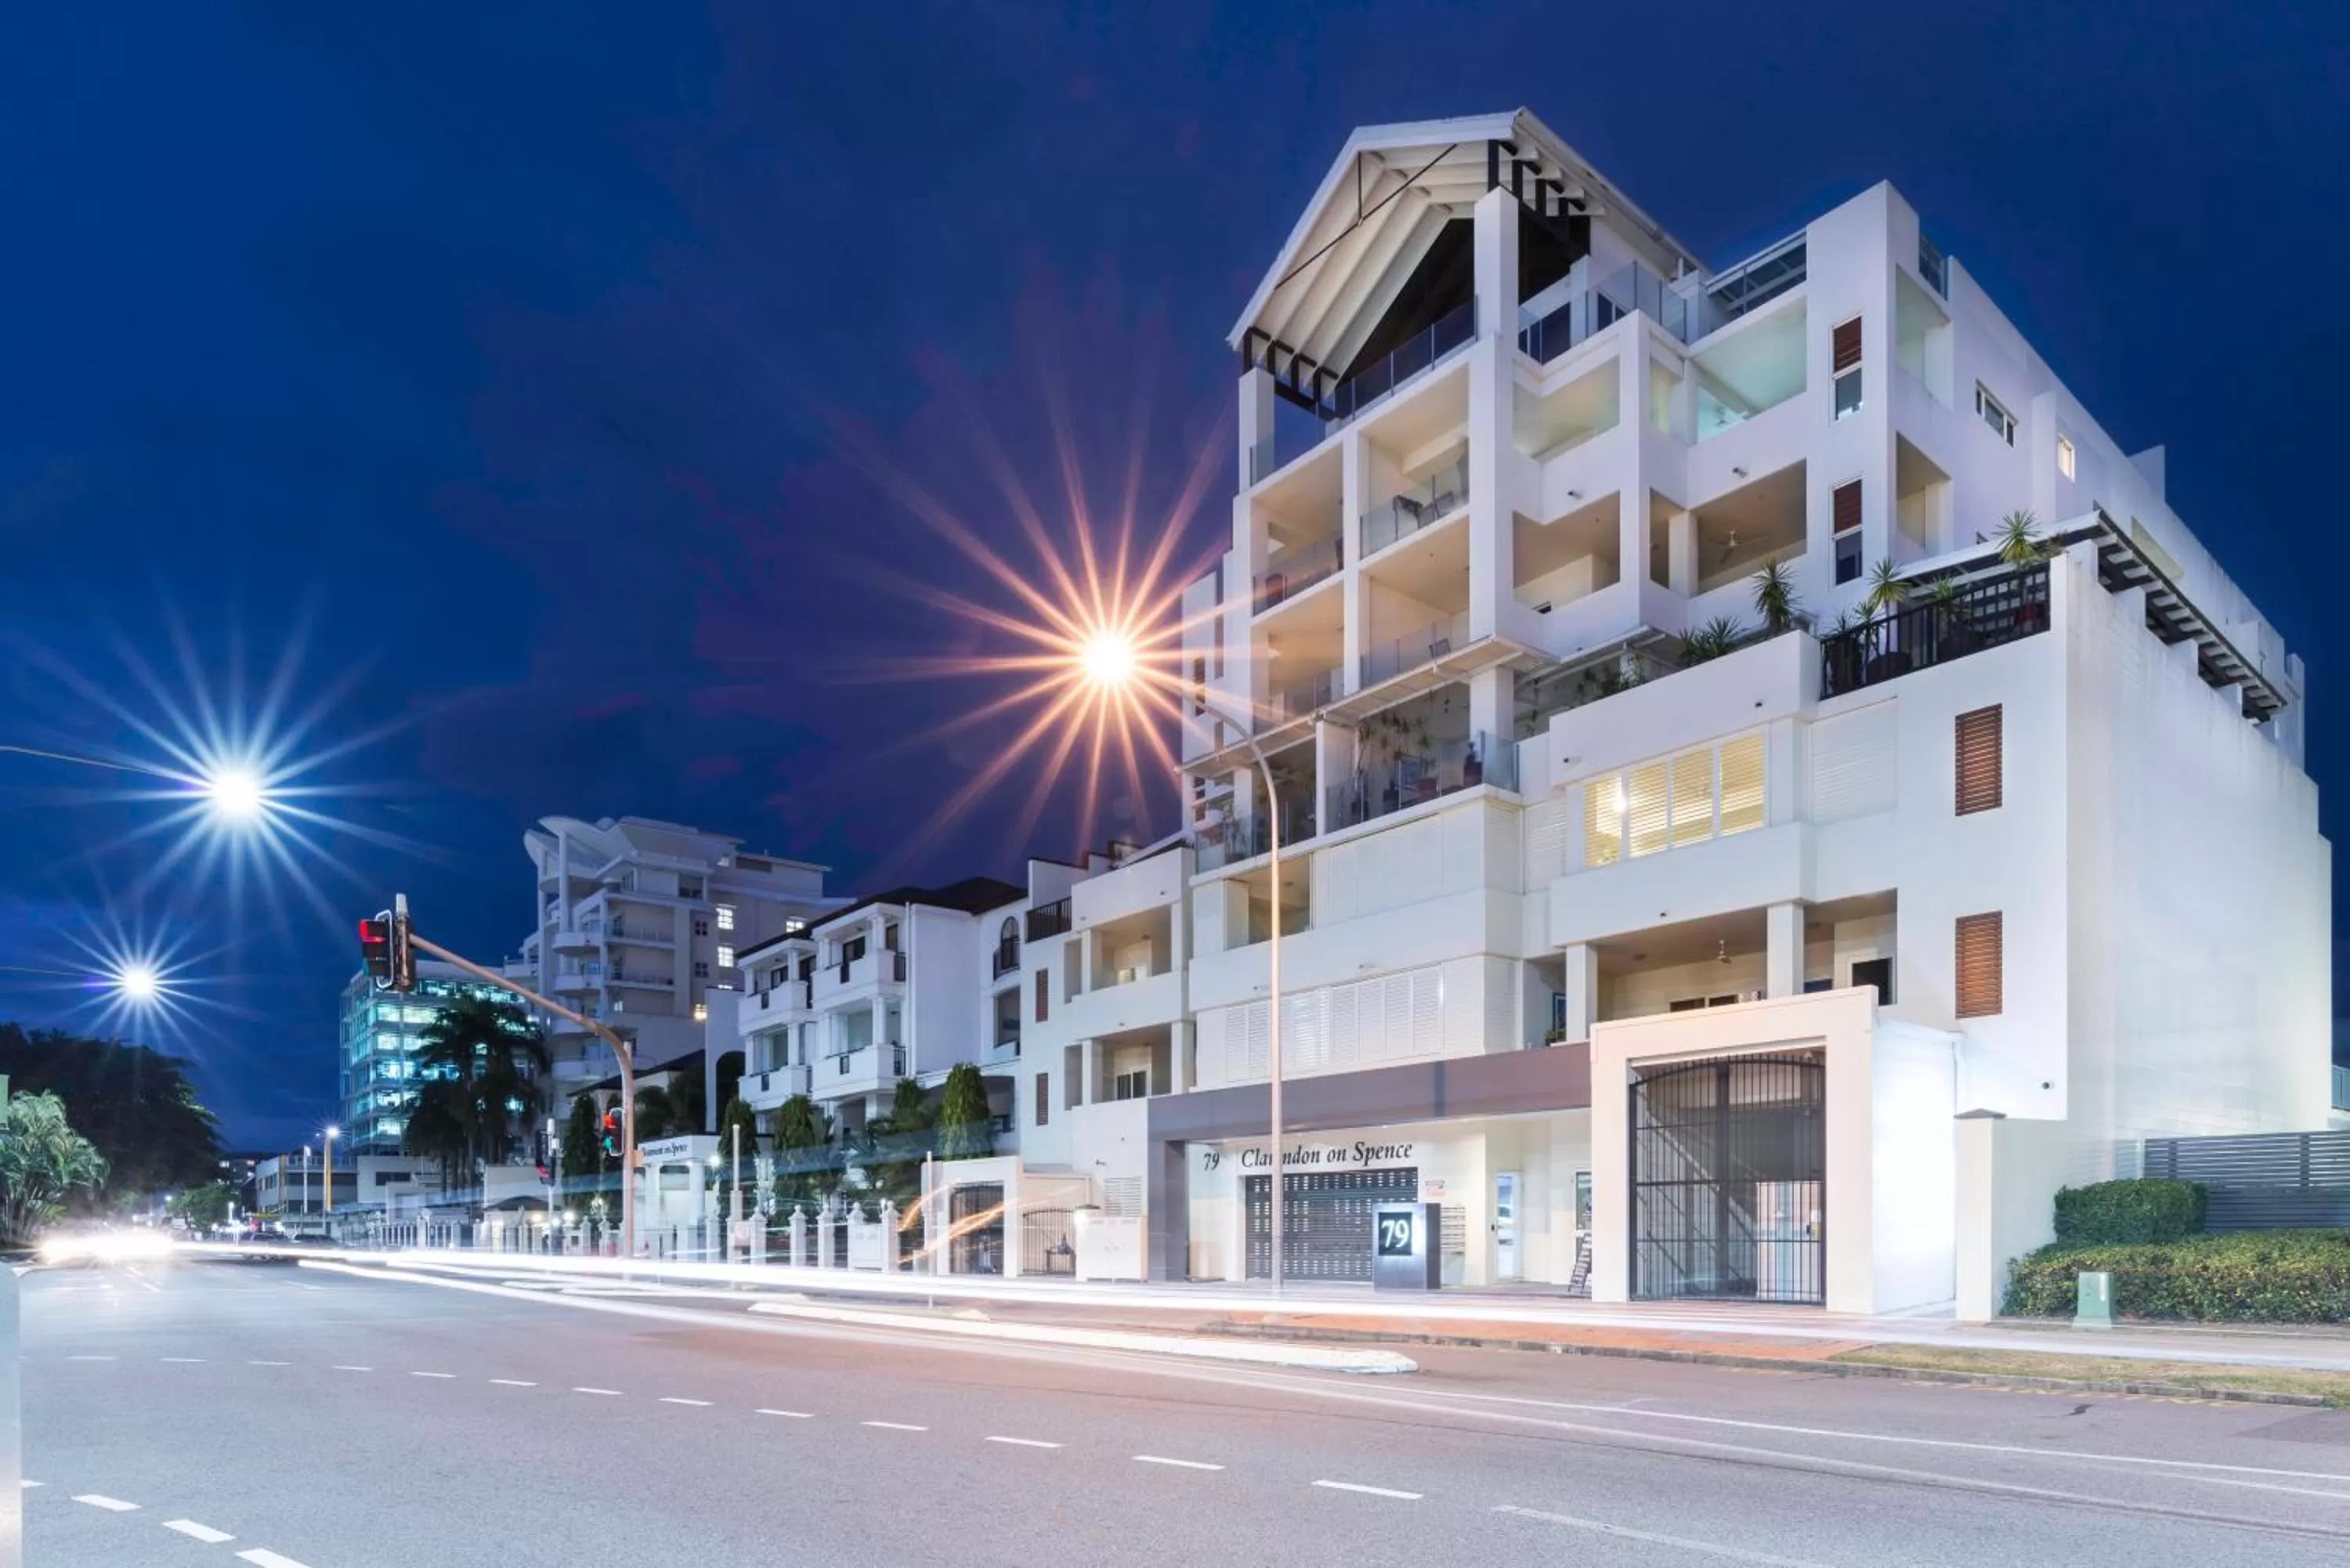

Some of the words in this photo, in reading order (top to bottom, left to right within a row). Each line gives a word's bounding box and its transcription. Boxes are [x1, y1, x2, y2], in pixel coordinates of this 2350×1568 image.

[1203, 1152, 1220, 1171] 79
[1242, 1144, 1321, 1168] Clarndon
[1327, 1147, 1347, 1163] on
[1353, 1141, 1412, 1166] Spence
[1381, 1219, 1409, 1248] 79
